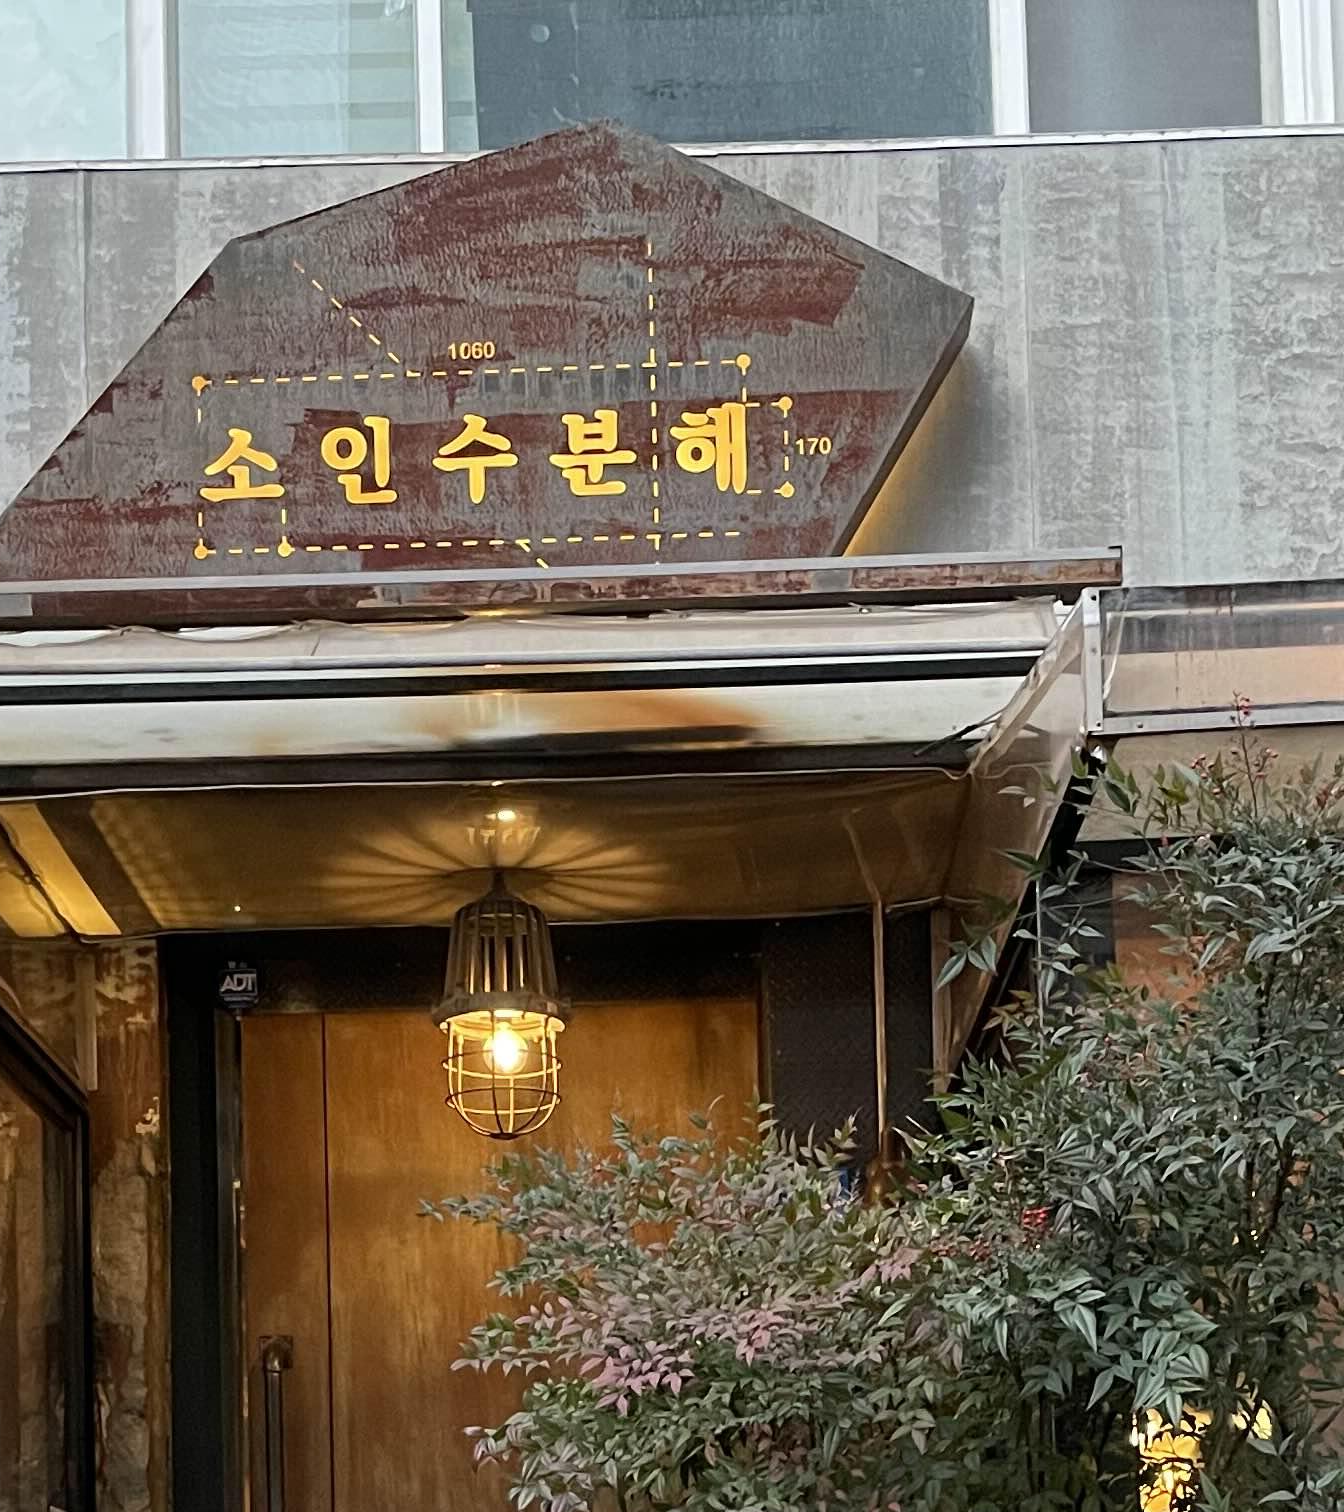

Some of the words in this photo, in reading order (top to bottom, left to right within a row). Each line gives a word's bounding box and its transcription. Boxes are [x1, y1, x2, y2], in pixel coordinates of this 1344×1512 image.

[447, 340, 496, 361] 1060
[199, 401, 749, 505] 소인수분해
[794, 435, 832, 456] 170
[219, 973, 257, 992] ADT
